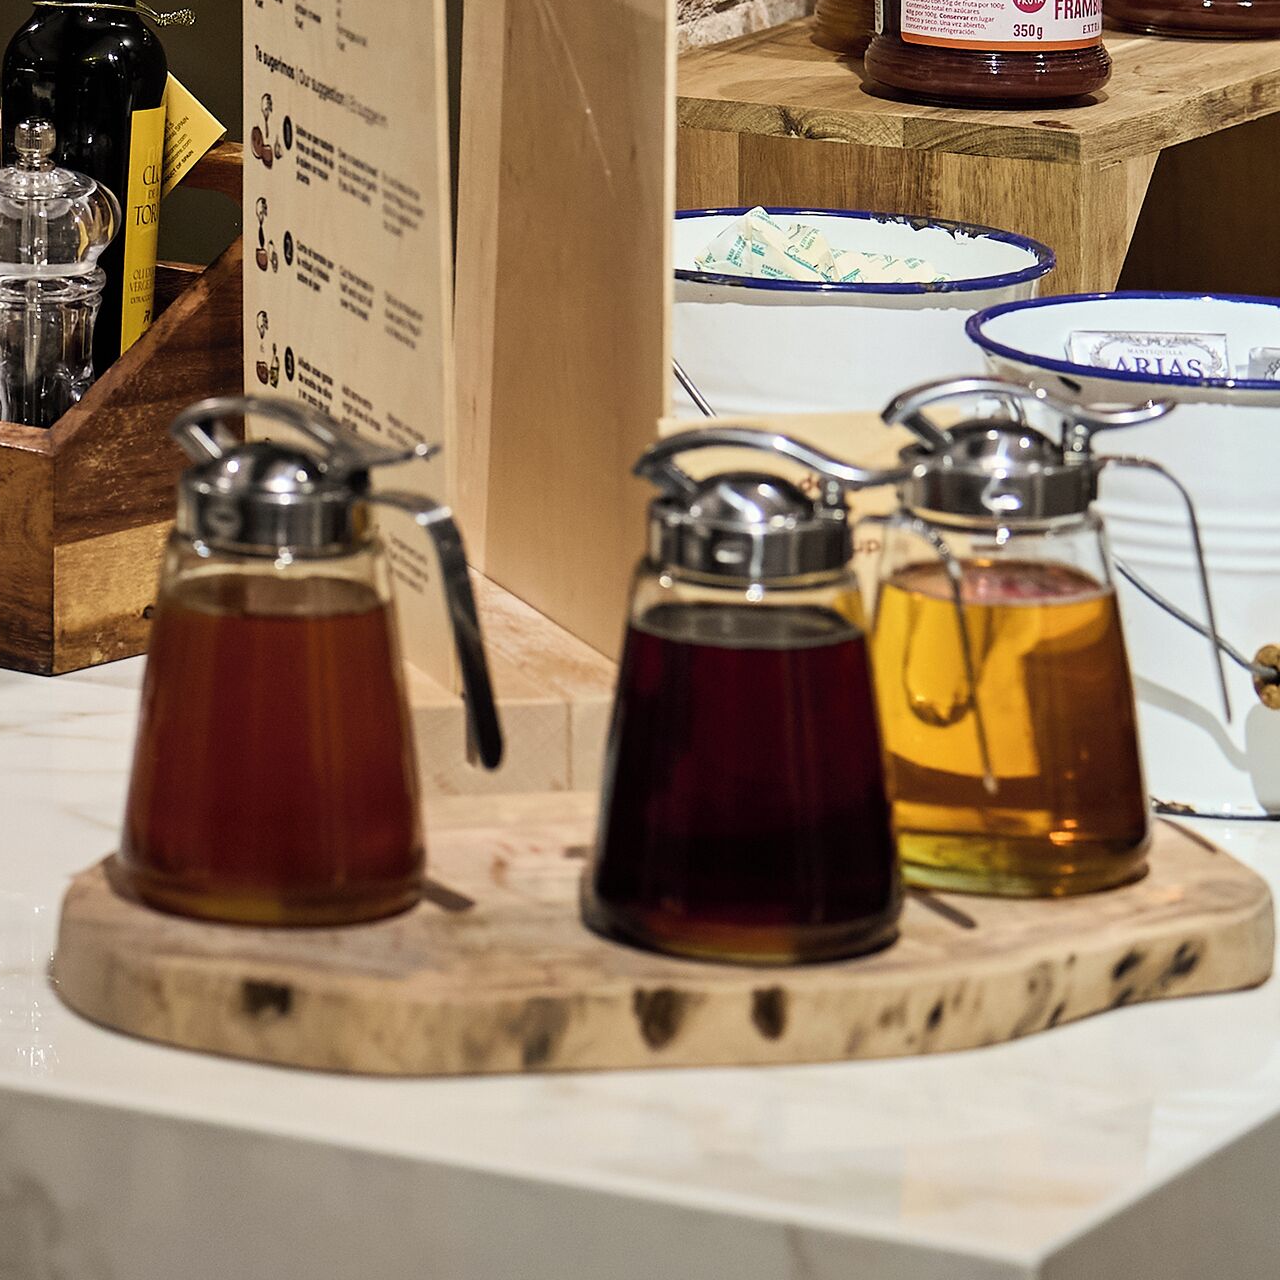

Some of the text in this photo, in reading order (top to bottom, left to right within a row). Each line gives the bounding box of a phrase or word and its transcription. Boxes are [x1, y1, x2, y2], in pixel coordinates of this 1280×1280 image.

[906, 1, 930, 10] Contenido
[134, 204, 158, 226] TOR
[1115, 356, 1204, 380] ARIAS
